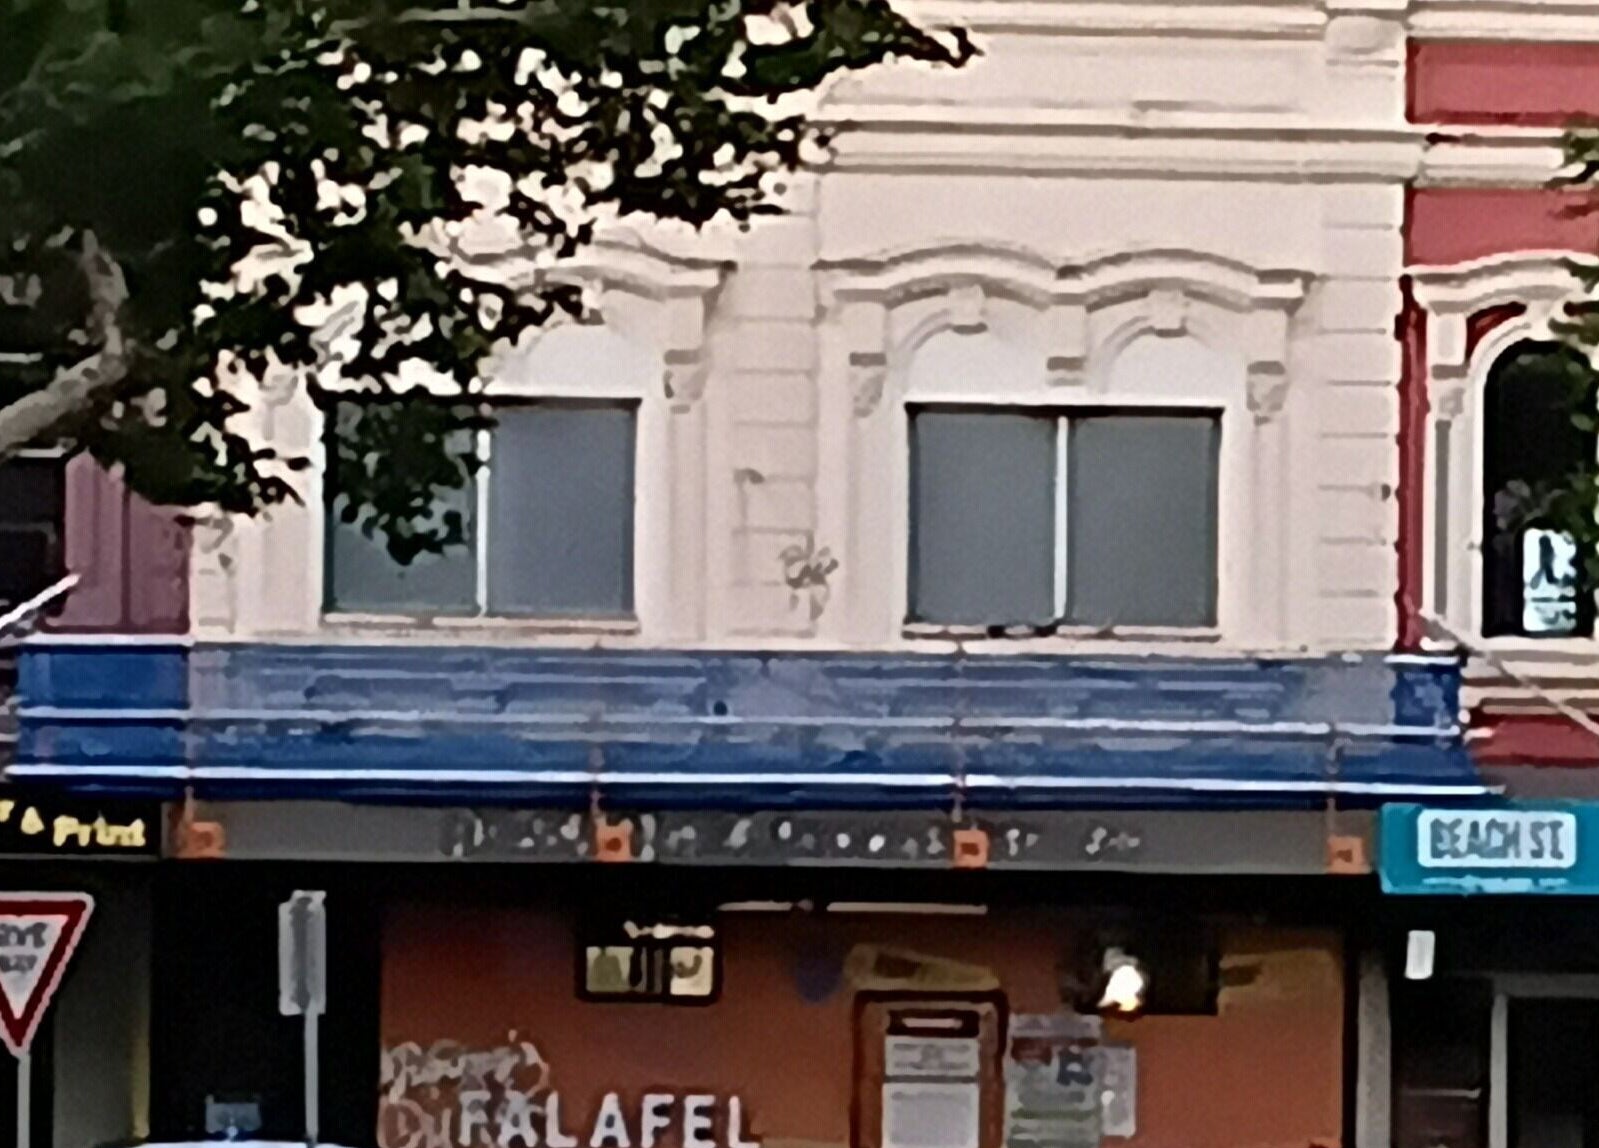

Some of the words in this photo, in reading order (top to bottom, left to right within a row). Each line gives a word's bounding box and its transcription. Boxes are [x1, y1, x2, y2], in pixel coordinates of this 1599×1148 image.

[53, 814, 146, 846] Print
[1431, 818, 1521, 859] BEACH
[1530, 820, 1564, 859] ST
